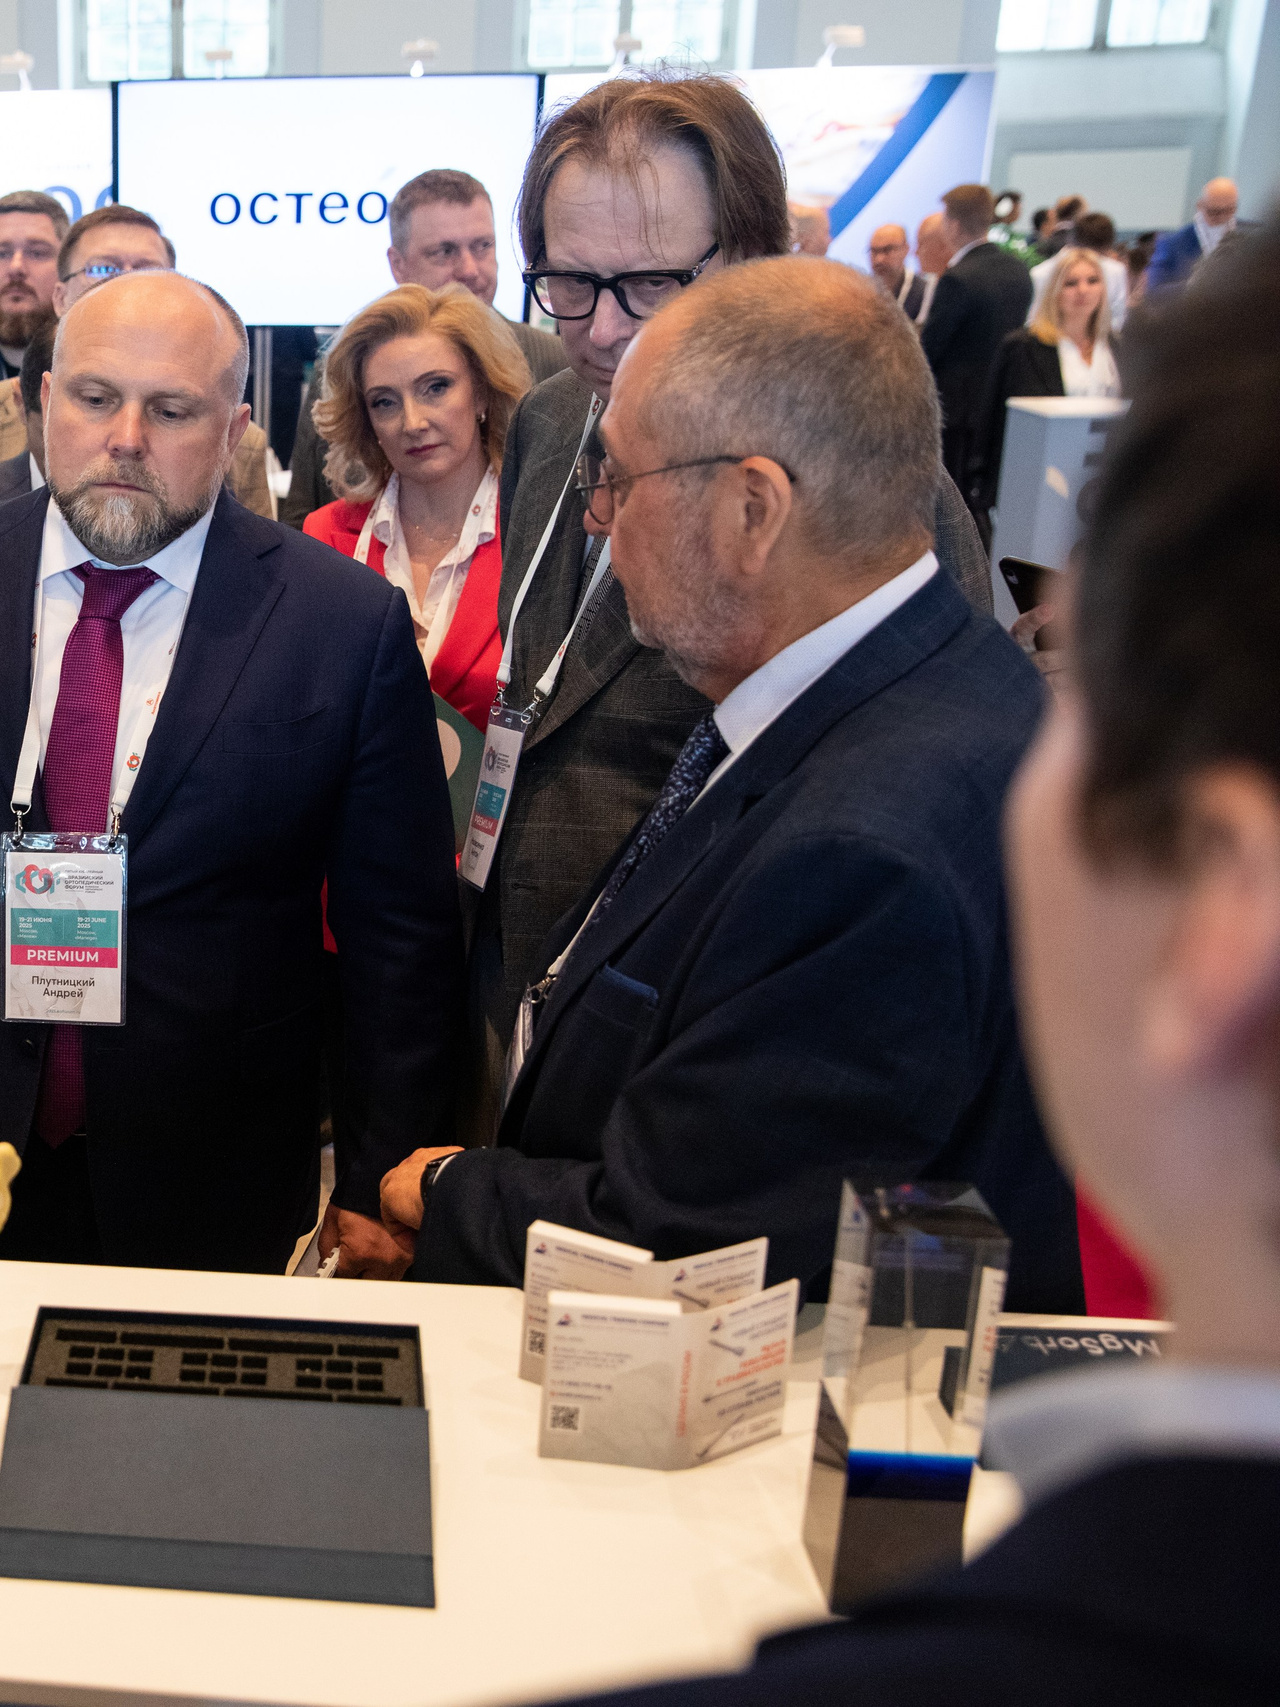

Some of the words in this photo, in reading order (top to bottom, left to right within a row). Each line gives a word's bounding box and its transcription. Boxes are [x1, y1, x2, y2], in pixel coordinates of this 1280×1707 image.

[27, 949, 99, 963] PREMIUM
[31, 975, 95, 988] Плутницкий
[42, 987, 84, 999] Андрей
